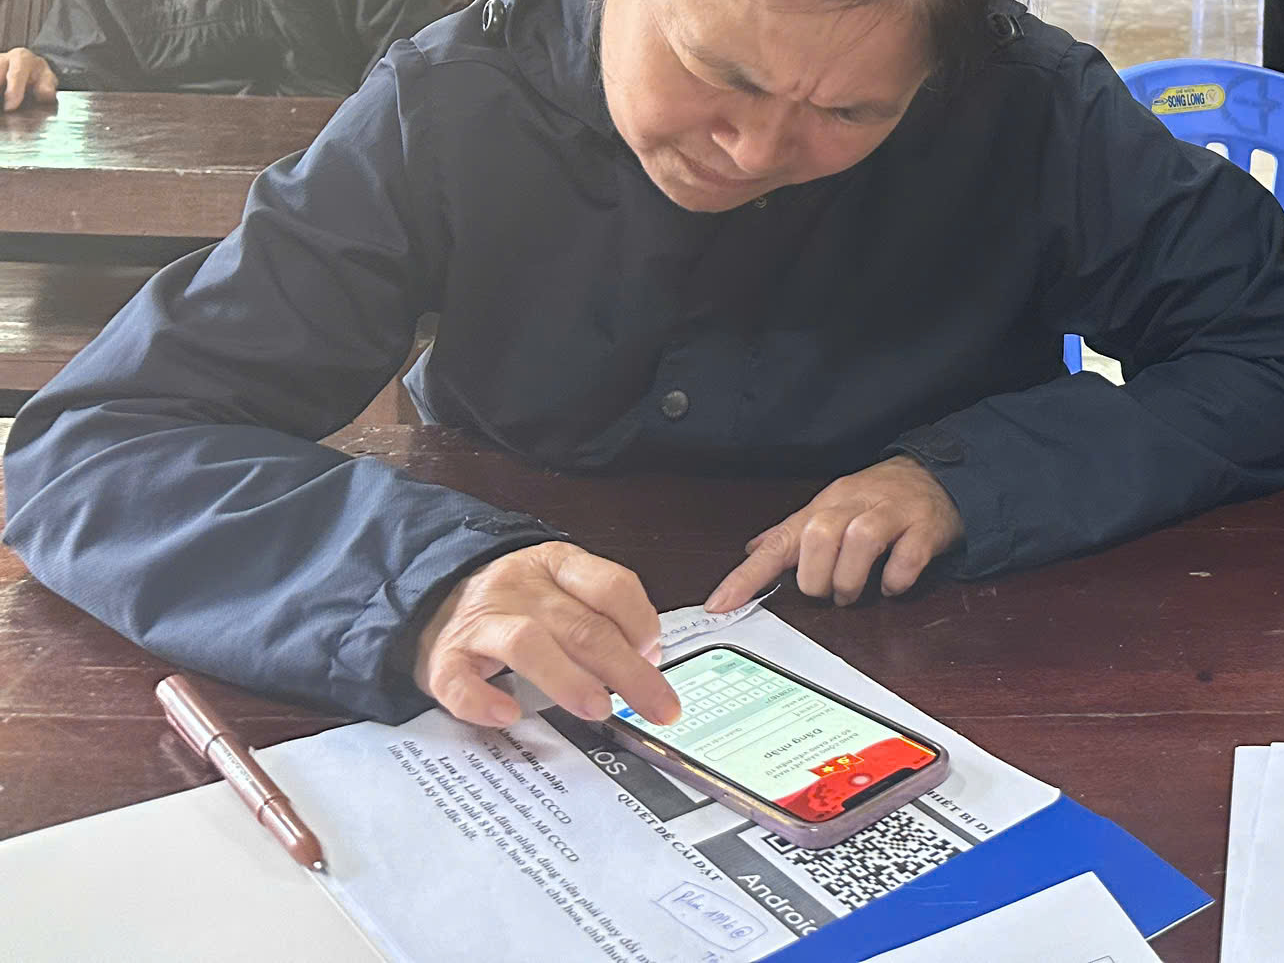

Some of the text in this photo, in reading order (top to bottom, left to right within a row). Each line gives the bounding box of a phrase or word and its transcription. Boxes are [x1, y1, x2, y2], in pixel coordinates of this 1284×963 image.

[1168, 94, 1186, 108] SONG
[1187, 92, 1205, 106] LONG
[540, 798, 571, 824] CCCD
[926, 787, 960, 811] HIẾT
[547, 834, 579, 862] CCCD
